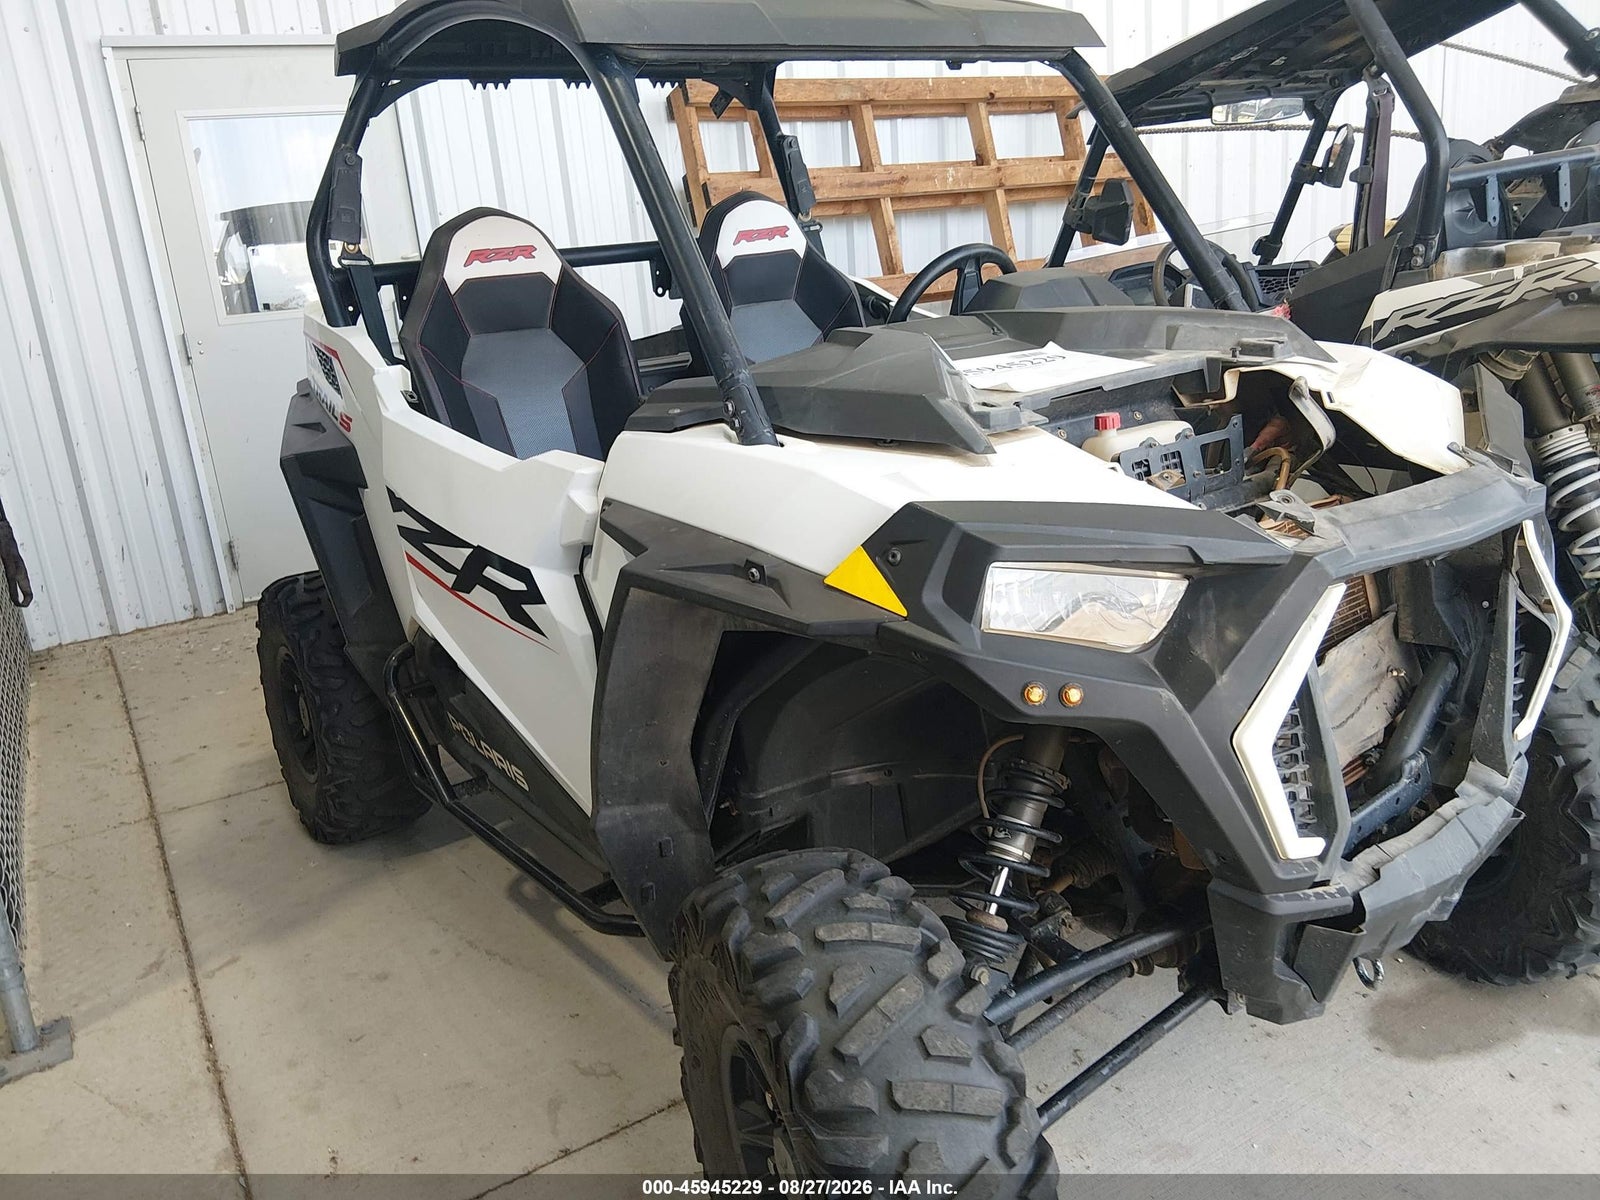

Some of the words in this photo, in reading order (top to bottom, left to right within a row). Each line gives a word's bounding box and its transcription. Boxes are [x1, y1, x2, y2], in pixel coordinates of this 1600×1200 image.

[733, 225, 790, 246] RZR
[464, 245, 537, 267] RZR
[1372, 258, 1597, 344] RZR
[962, 354, 1067, 378] 5945229
[338, 411, 353, 433] S
[446, 711, 529, 792] POLARIS
